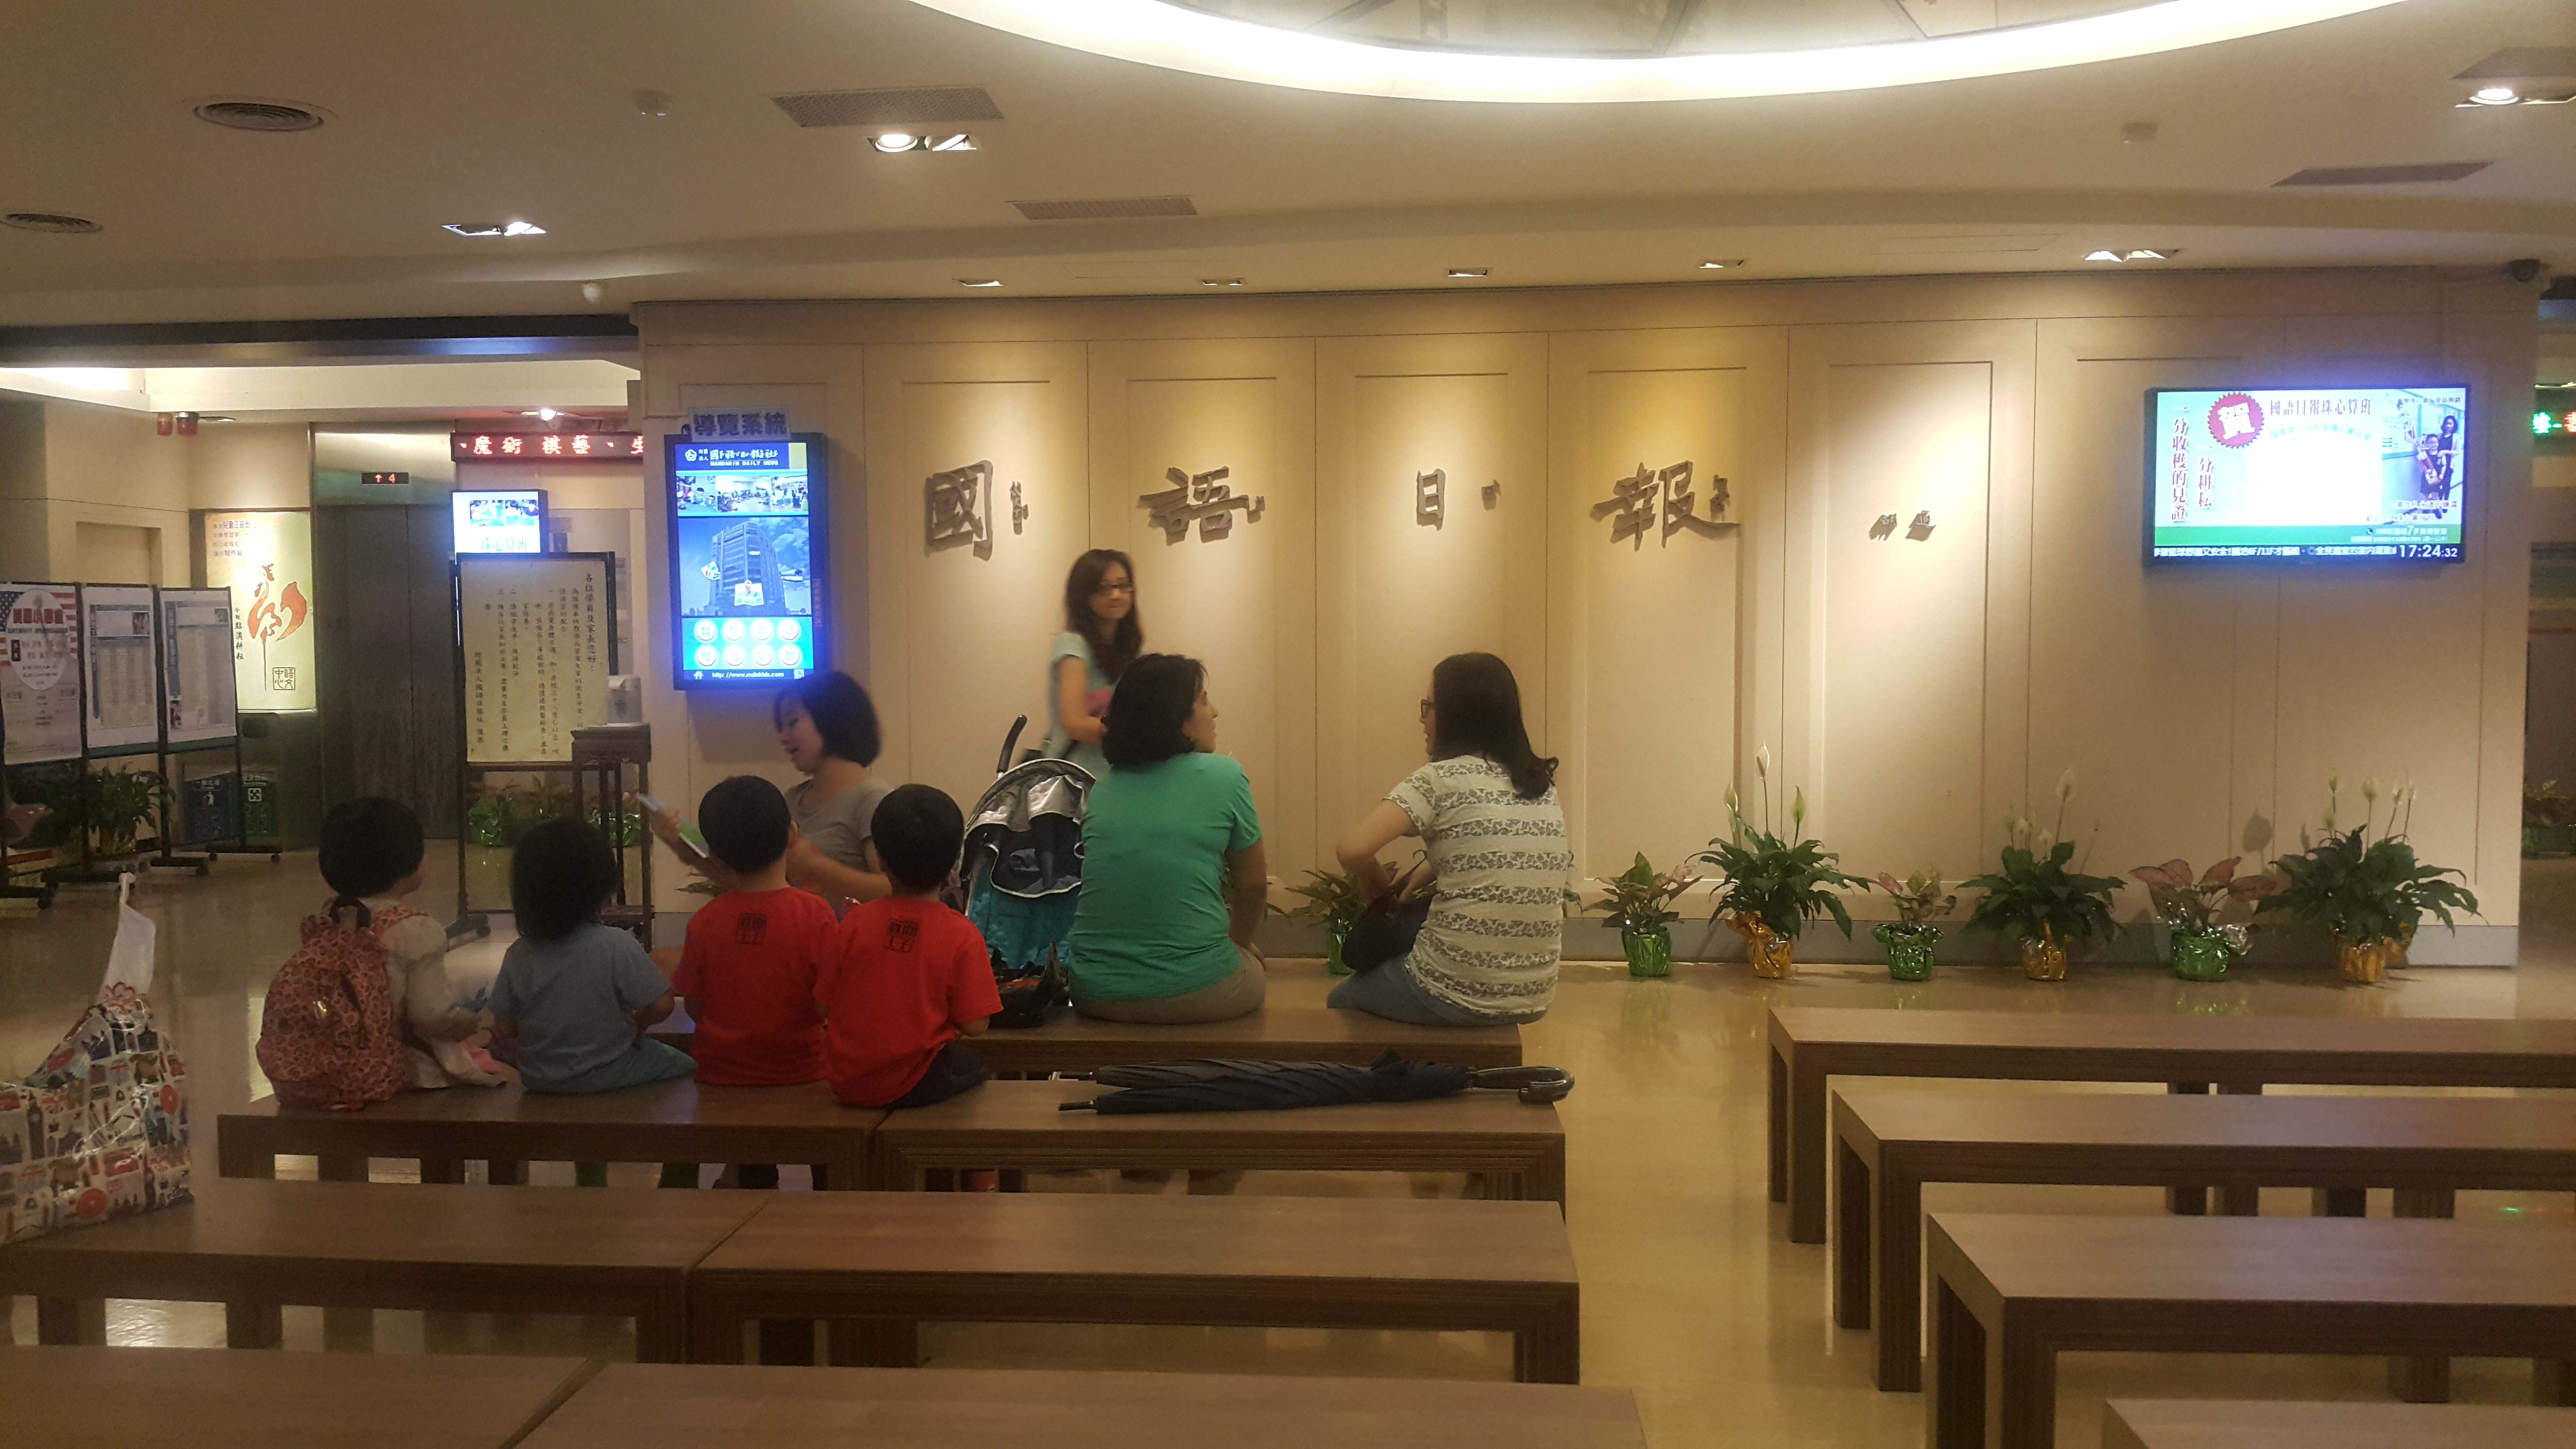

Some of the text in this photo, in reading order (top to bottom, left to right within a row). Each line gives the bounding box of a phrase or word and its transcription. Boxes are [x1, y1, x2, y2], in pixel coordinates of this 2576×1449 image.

[693, 413, 787, 435] 導覽系統
[2217, 402, 2255, 440] 賀
[388, 474, 396, 483] 4
[2400, 545, 2457, 557] 17:24:32
